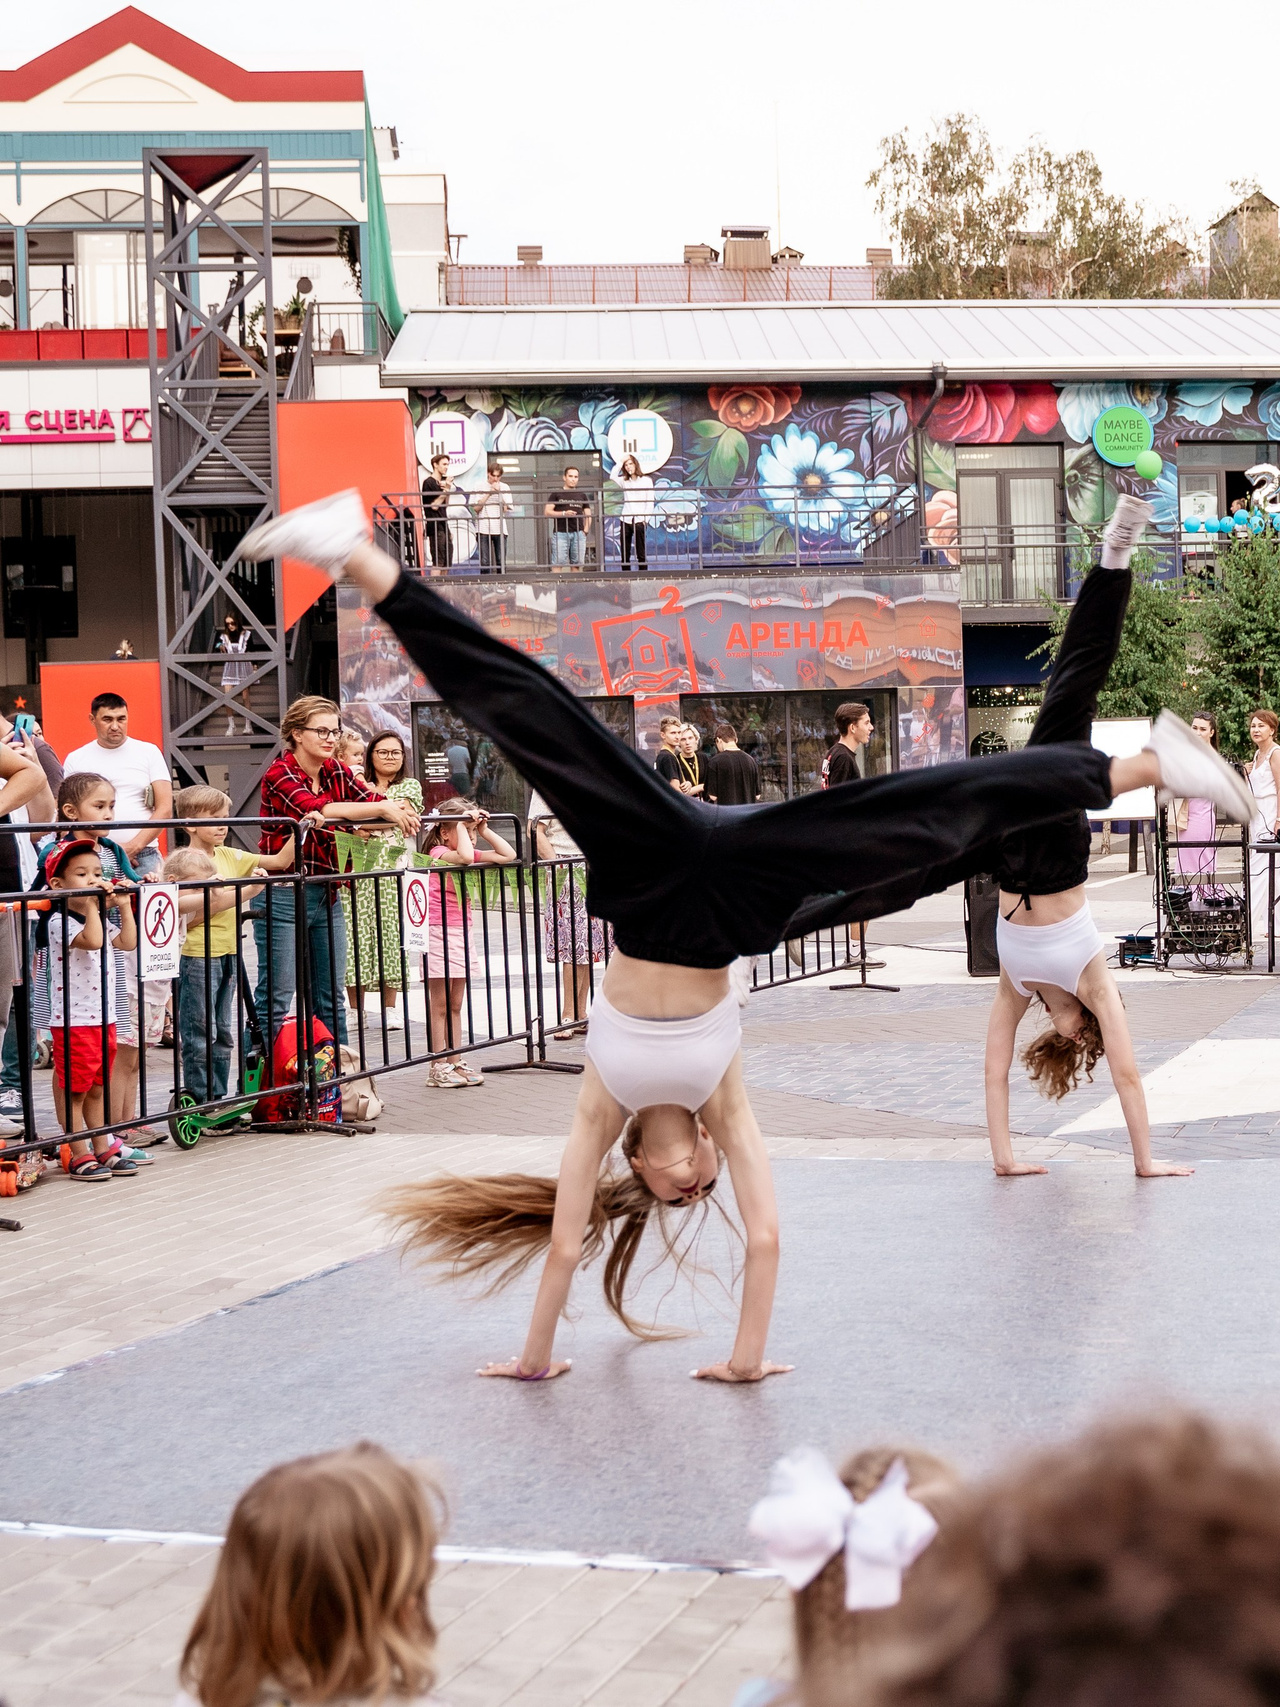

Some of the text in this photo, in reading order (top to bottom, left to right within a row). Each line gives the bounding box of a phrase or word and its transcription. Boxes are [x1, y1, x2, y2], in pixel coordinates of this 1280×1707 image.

[25, 409, 115, 434] СЦЕНА
[1103, 420, 1143, 430] MAYBE
[1104, 432, 1143, 442] DANCE
[725, 620, 870, 653] АРЕНДА
[524, 637, 545, 652] 15
[753, 651, 784, 659] аренды
[150, 952, 172, 962] ПРОХОД
[146, 962, 176, 972] ЗАПРЕЩЕН
